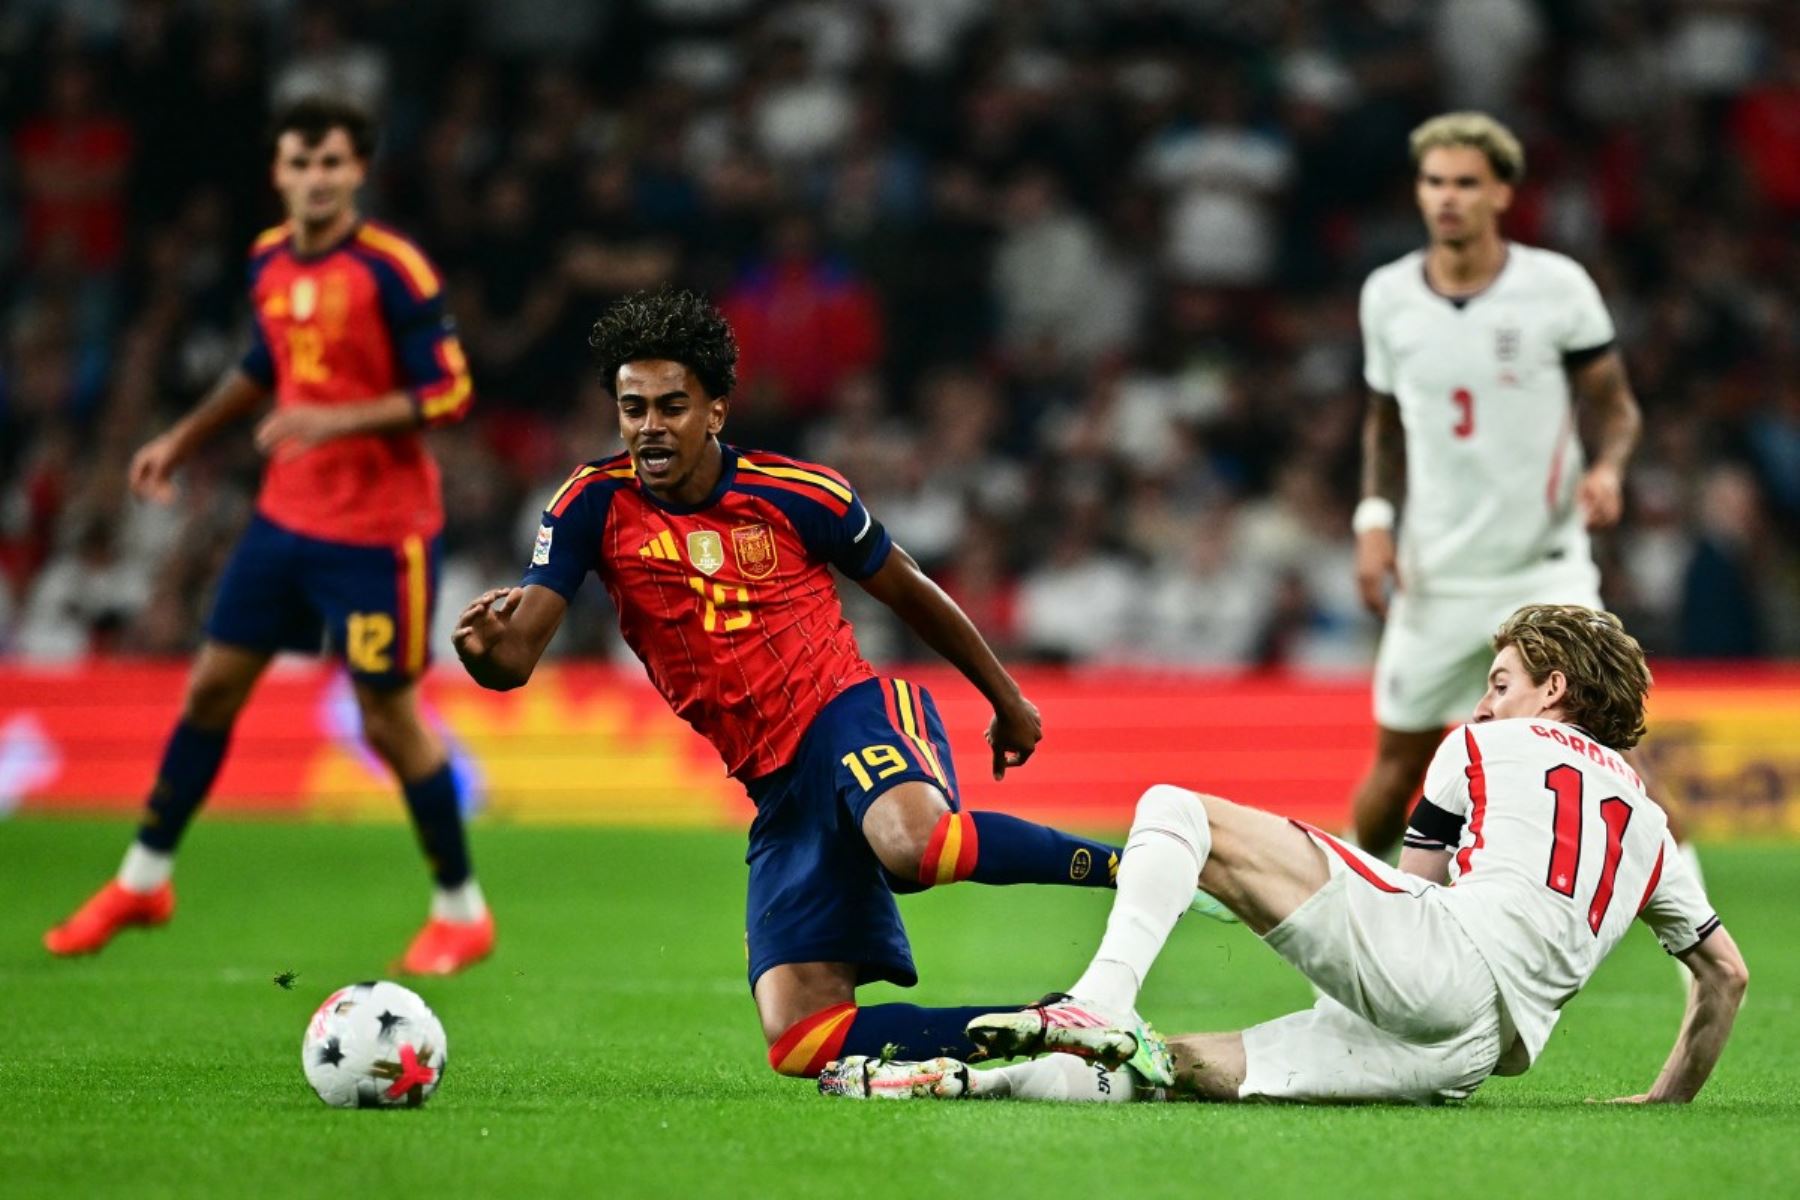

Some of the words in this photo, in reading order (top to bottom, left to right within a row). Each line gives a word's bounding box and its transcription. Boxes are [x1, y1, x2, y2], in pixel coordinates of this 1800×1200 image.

[1451, 387, 1476, 440] 3
[347, 613, 394, 673] 12
[841, 744, 908, 793] 19
[1545, 763, 1633, 939] 11
[1094, 1061, 1111, 1095] NG
